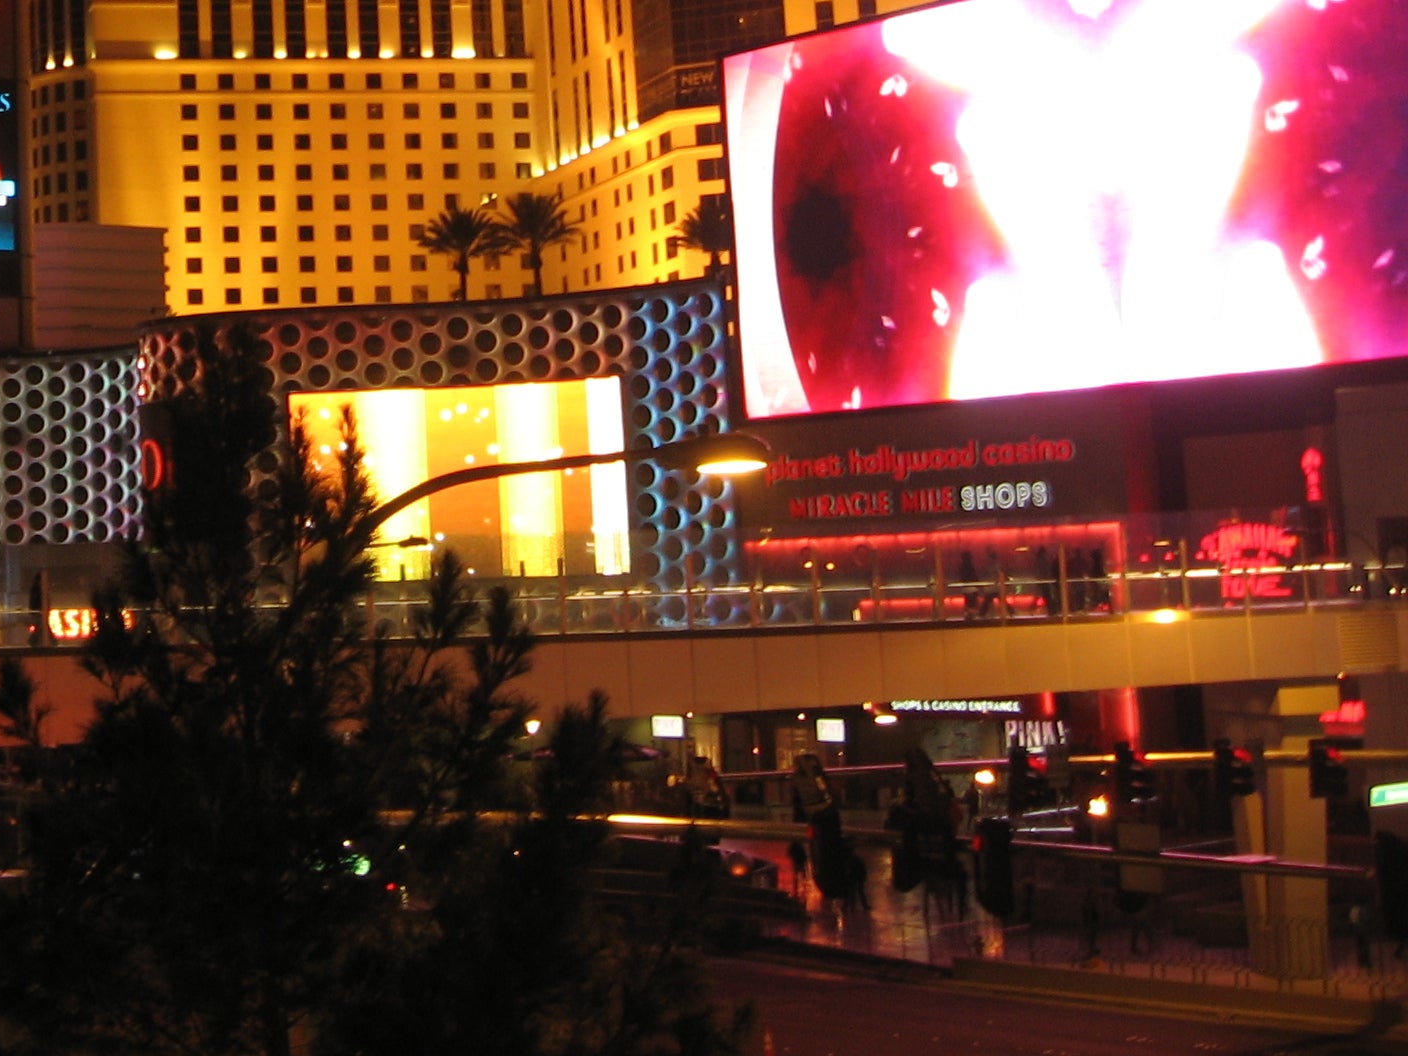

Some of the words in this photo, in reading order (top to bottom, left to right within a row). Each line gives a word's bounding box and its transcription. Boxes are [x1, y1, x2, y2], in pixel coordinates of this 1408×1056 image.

[765, 452, 842, 486] planet
[847, 440, 979, 481] hollywood
[981, 437, 1074, 466] casino
[790, 491, 891, 518] MIRACLE
[900, 487, 954, 513] MILE
[959, 481, 1049, 511] SHOPS
